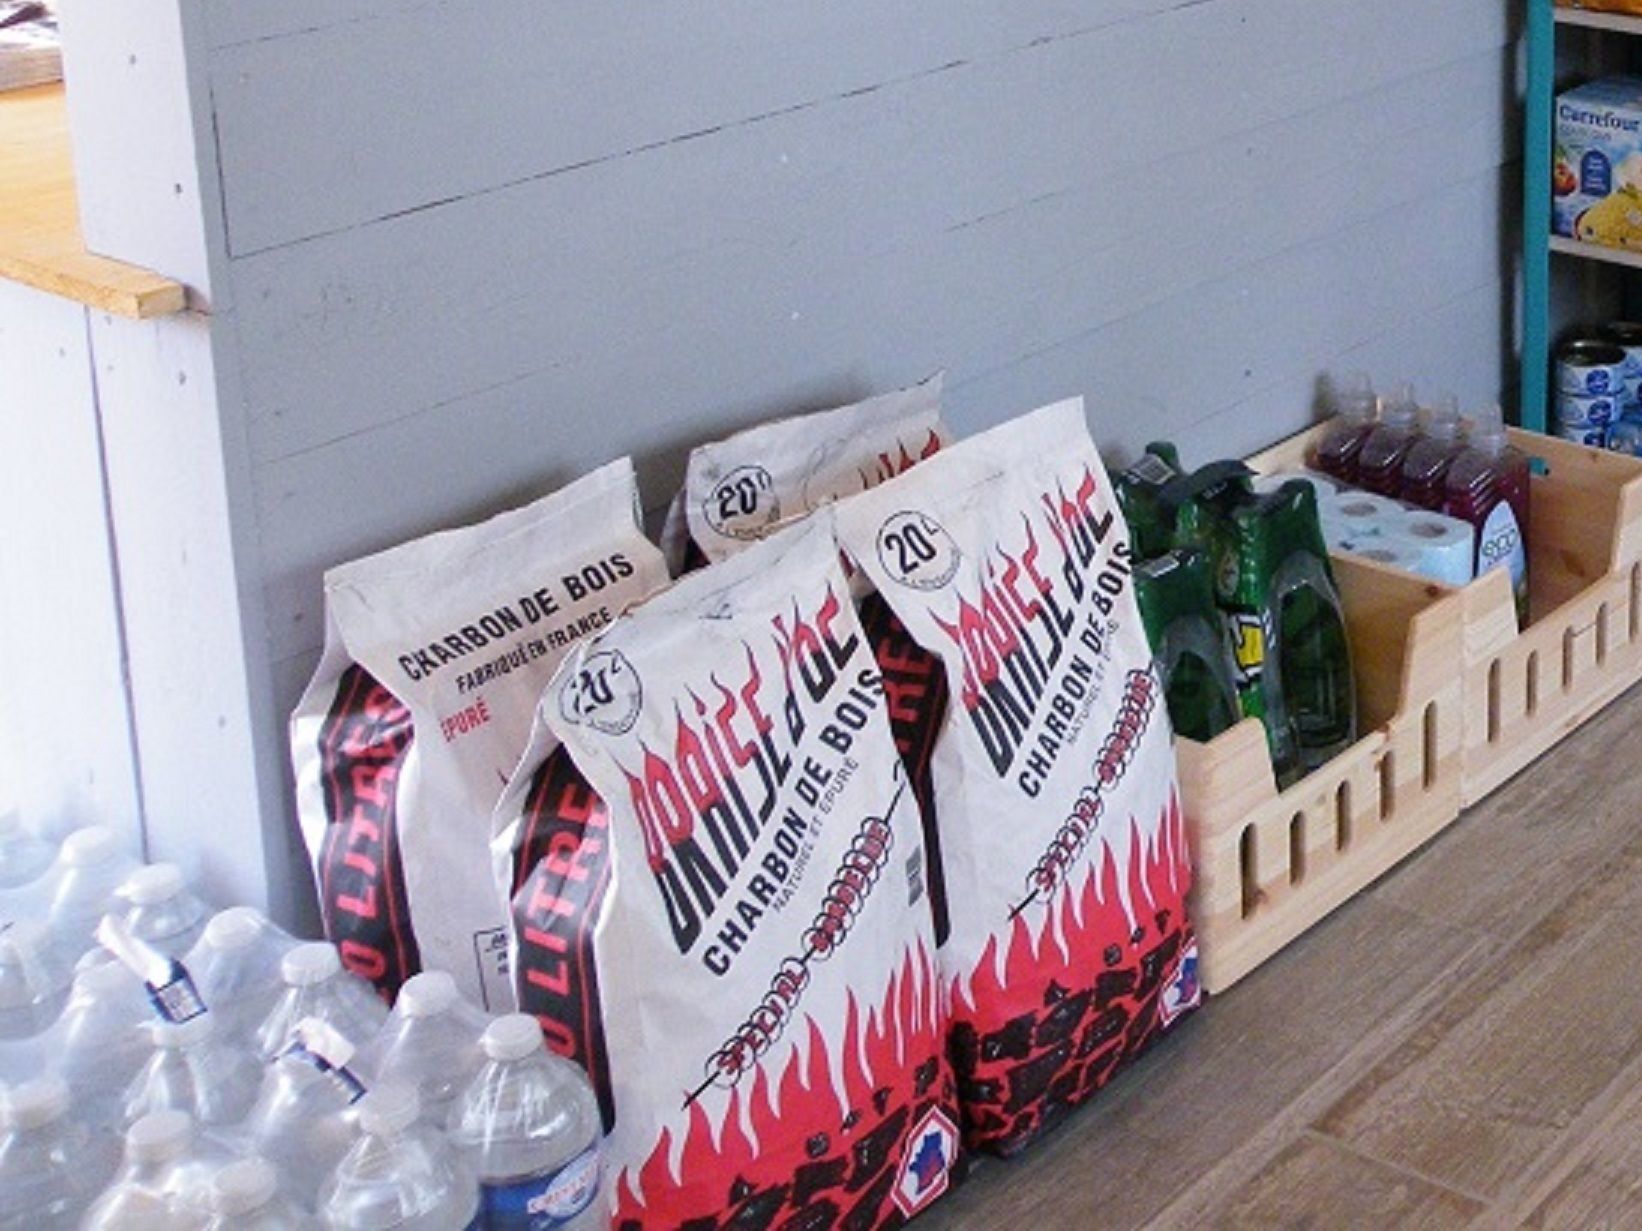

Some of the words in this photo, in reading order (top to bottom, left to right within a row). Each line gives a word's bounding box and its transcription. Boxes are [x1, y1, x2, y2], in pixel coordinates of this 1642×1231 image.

[1559, 104, 1641, 132] Carrefour
[398, 608, 524, 683] CHARBON
[519, 591, 560, 625] DE
[563, 553, 635, 606] BOIS
[548, 605, 615, 653] FRANCE
[1018, 656, 1087, 800] CHARBON
[1087, 616, 1105, 664] DE
[1097, 540, 1134, 616] BOIS
[702, 804, 810, 978] CHARBON
[792, 754, 826, 805] DE
[818, 667, 888, 758] BOIS
[771, 834, 813, 913] NATUREL
[810, 818, 892, 954] BARBECUE
[525, 778, 610, 1001] LITRE
